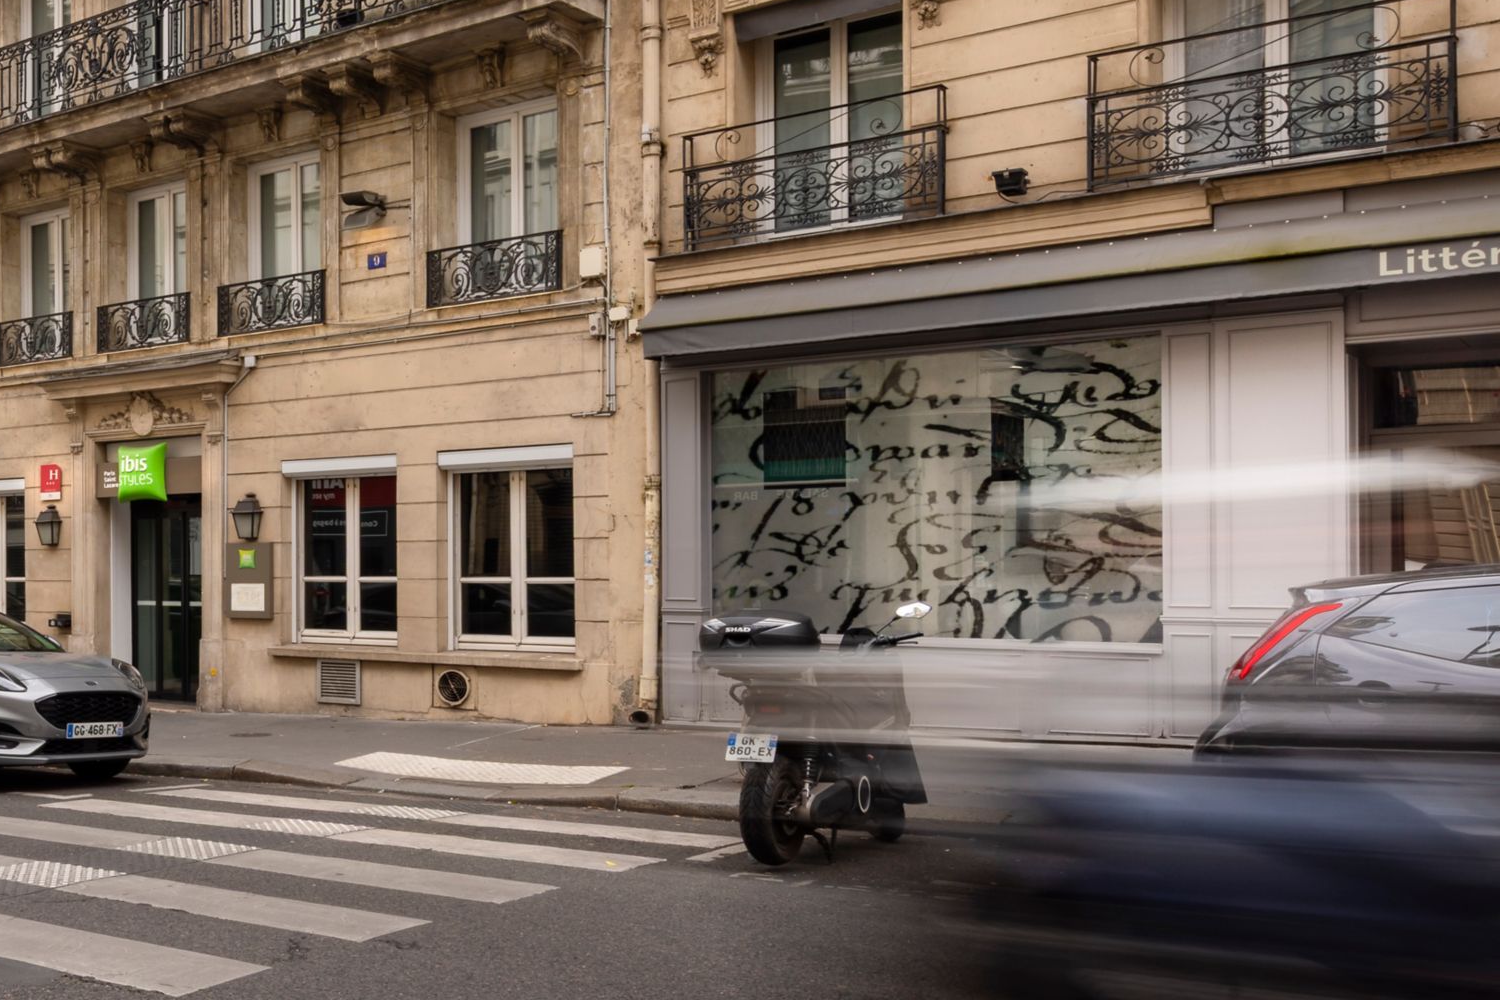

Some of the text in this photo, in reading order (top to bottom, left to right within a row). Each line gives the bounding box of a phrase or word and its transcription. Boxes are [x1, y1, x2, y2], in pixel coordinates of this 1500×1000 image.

[120, 455, 148, 473] ibis
[49, 469, 58, 480] H
[729, 746, 773, 757] 860-EX
